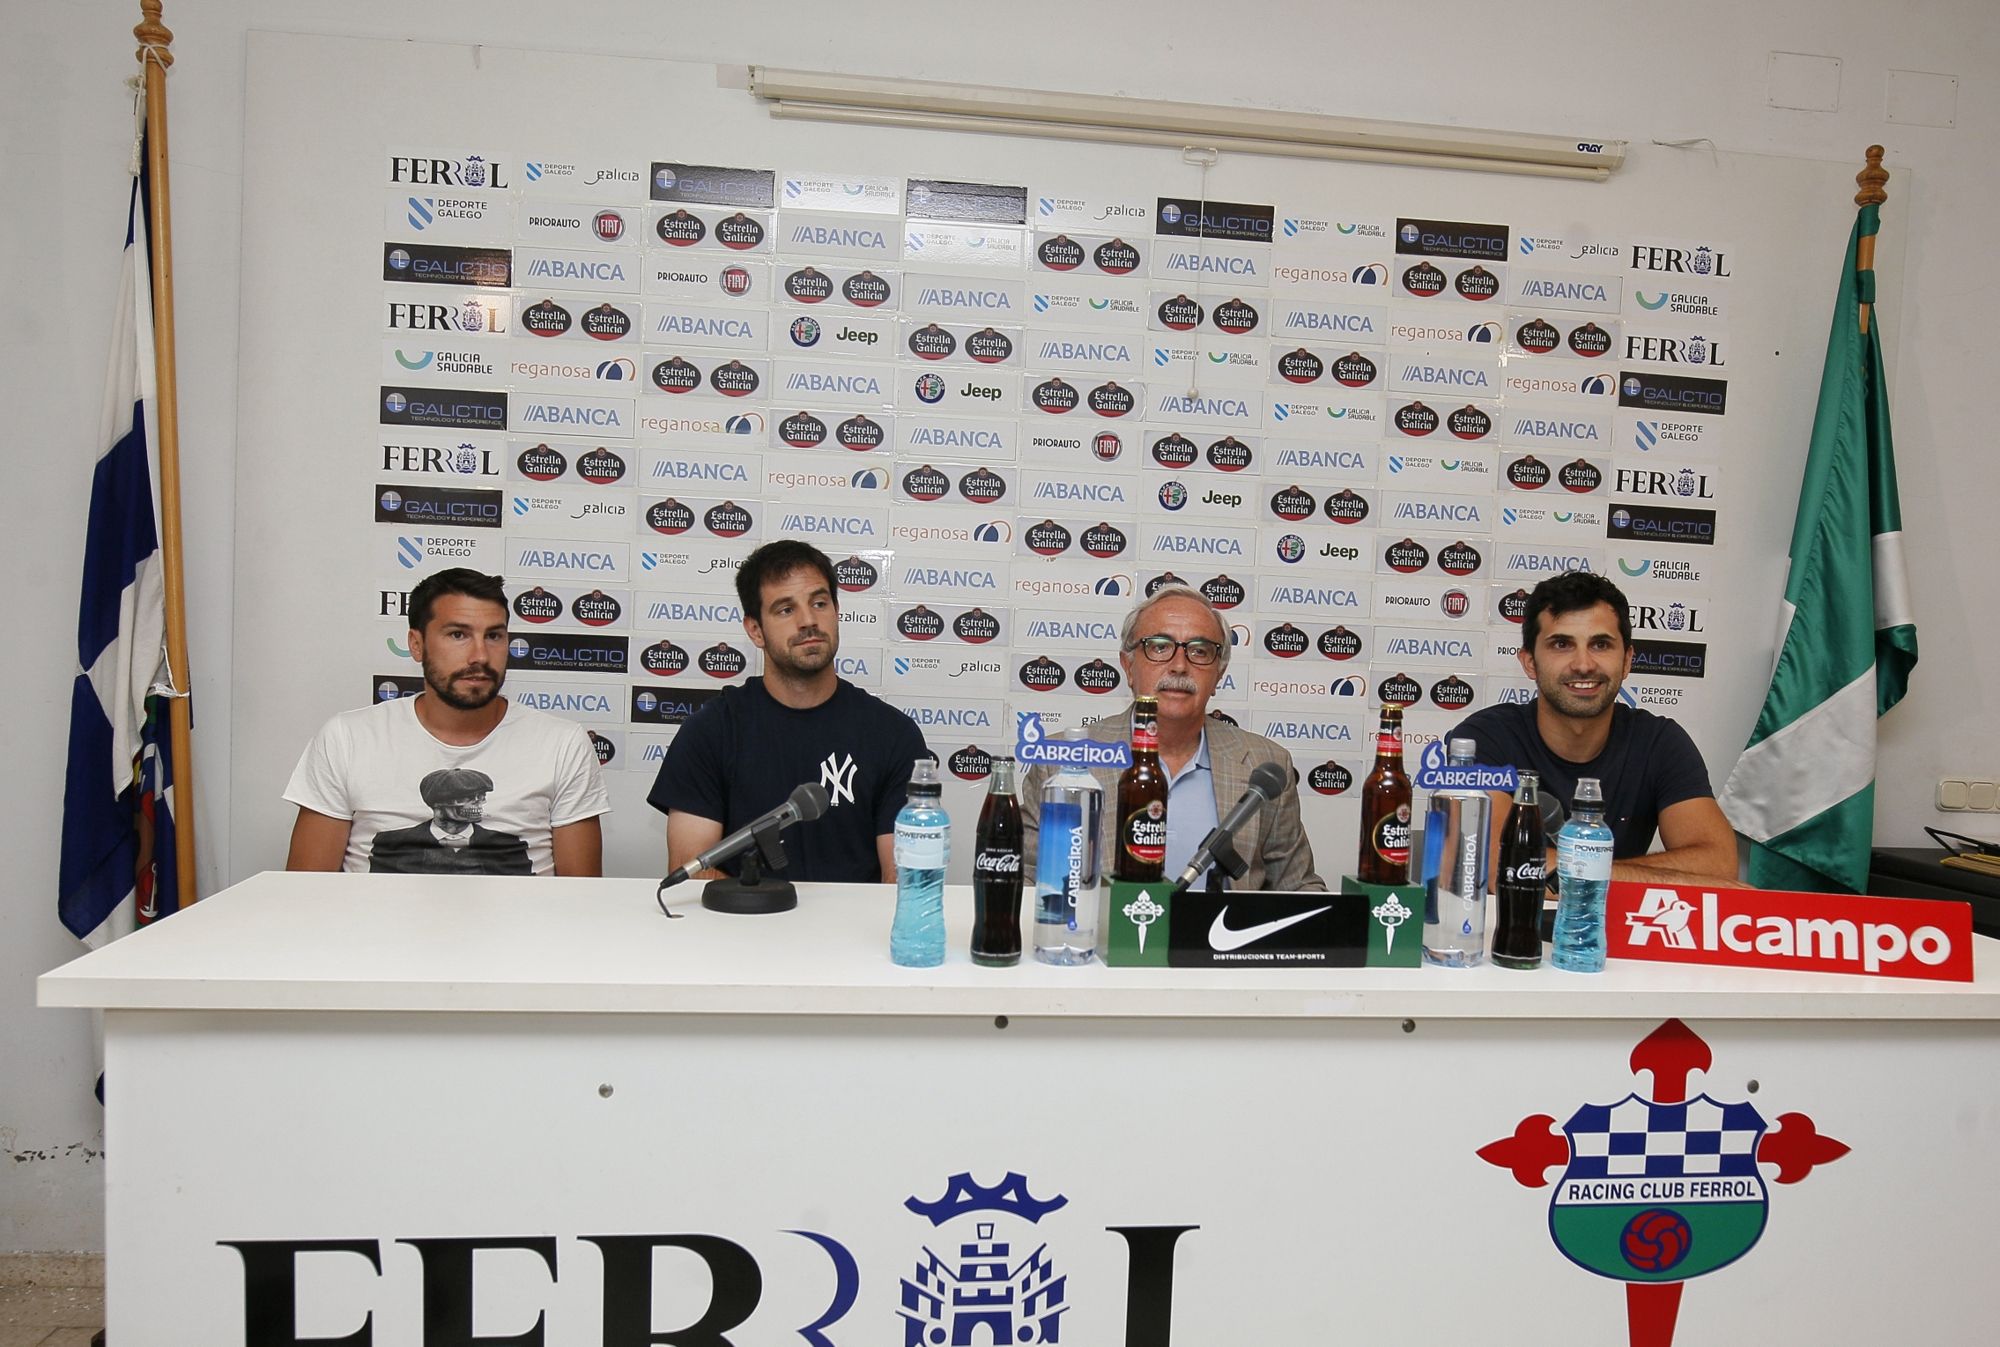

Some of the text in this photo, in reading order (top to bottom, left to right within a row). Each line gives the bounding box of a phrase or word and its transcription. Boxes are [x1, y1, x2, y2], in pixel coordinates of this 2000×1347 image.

[596, 167, 640, 182] galicia
[1105, 204, 1145, 218] galicia
[528, 217, 581, 229] PRIORAUTO
[599, 219, 620, 234] FIAT
[663, 219, 700, 231] Estrella
[1183, 215, 1269, 231] GALICTIO
[664, 226, 698, 242] Galicia
[1421, 233, 1504, 251] GALICTIO
[1044, 243, 1079, 255] Estrella
[1582, 243, 1619, 256] galicia
[1045, 252, 1078, 266] Galicia
[657, 272, 708, 283] PRIORAUTO
[726, 273, 745, 289] FIAT
[1274, 265, 1347, 287] reganosa
[1409, 270, 1442, 282] Estrella
[1410, 279, 1441, 292] Galicia
[1671, 294, 1708, 305] GALICIA
[1218, 308, 1254, 320] Estrella
[1670, 304, 1718, 315] SAUDABLE
[587, 314, 625, 326] Estrella
[1219, 316, 1252, 330] Galicia
[589, 323, 623, 336] Galicia
[836, 327, 878, 345] Jeep
[1391, 323, 1463, 344] reganosa
[914, 335, 951, 346] Estrella
[1574, 331, 1607, 343] Estrella
[915, 344, 949, 357] Galicia
[1575, 340, 1606, 353] Galicia
[436, 352, 480, 363] GALICIA
[1285, 358, 1318, 369] Estrella
[437, 362, 493, 374] SAUDABLE
[511, 360, 591, 380] reganosa
[1284, 367, 1318, 380] Galicia
[717, 369, 754, 382] Estrella
[718, 379, 752, 391] Galicia
[1506, 375, 1577, 396] reganosa
[960, 383, 1002, 401] Jeep
[1093, 392, 1130, 404] Estrella
[1643, 387, 1722, 405] GALICTIO
[410, 404, 502, 419] GALICTIO
[1095, 401, 1127, 413] Galicia
[641, 417, 720, 434] reganosa
[1032, 437, 1081, 450] PRIORAUTO
[1098, 439, 1117, 454] FIAT
[1212, 447, 1247, 459] Estrella
[524, 454, 561, 466] Estrella
[1213, 455, 1245, 468] Galicia
[525, 462, 559, 477] Galicia
[1565, 468, 1597, 479] Estrella
[768, 471, 846, 489] reganosa
[1565, 477, 1596, 490] Galicia
[1201, 490, 1242, 507] Jeep
[1276, 495, 1311, 506] Estrella
[404, 500, 498, 517] GALICTIO
[583, 502, 626, 517] galicia
[652, 508, 689, 520] Estrella
[1277, 503, 1309, 516] Galicia
[653, 516, 687, 530] Galicia
[1632, 518, 1711, 536] GALICTIO
[892, 524, 969, 542] reganosa
[1086, 533, 1122, 545] Estrella
[1087, 542, 1119, 555] Galicia
[1319, 543, 1359, 560] Jeep
[1443, 550, 1477, 562] Estrella
[1443, 559, 1475, 572] Galicia
[1653, 560, 1690, 571] GALICIA
[1653, 570, 1700, 581] SAUDABLE
[1015, 578, 1090, 596] reganosa
[578, 601, 616, 612] Estrella
[1385, 595, 1431, 607] PRIORAUTO
[1448, 597, 1465, 611] FIAT
[579, 610, 613, 623] Galicia
[959, 619, 995, 630] Estrella
[960, 628, 993, 640] Galicia
[1322, 635, 1357, 647] Estrella
[532, 647, 624, 663] GALICTIO
[1323, 645, 1355, 657] Galicia
[705, 654, 742, 666] Estrella
[960, 659, 1001, 674] galicia
[706, 662, 739, 676] Galicia
[1025, 666, 1061, 677] Estrella
[1026, 675, 1059, 688] Galicia
[1254, 677, 1326, 697] reganosa
[976, 852, 1021, 872] Coca-Cola
[1625, 888, 1952, 973] Alcampo
[1568, 1181, 1756, 1202] RACING CLUB FERROL
